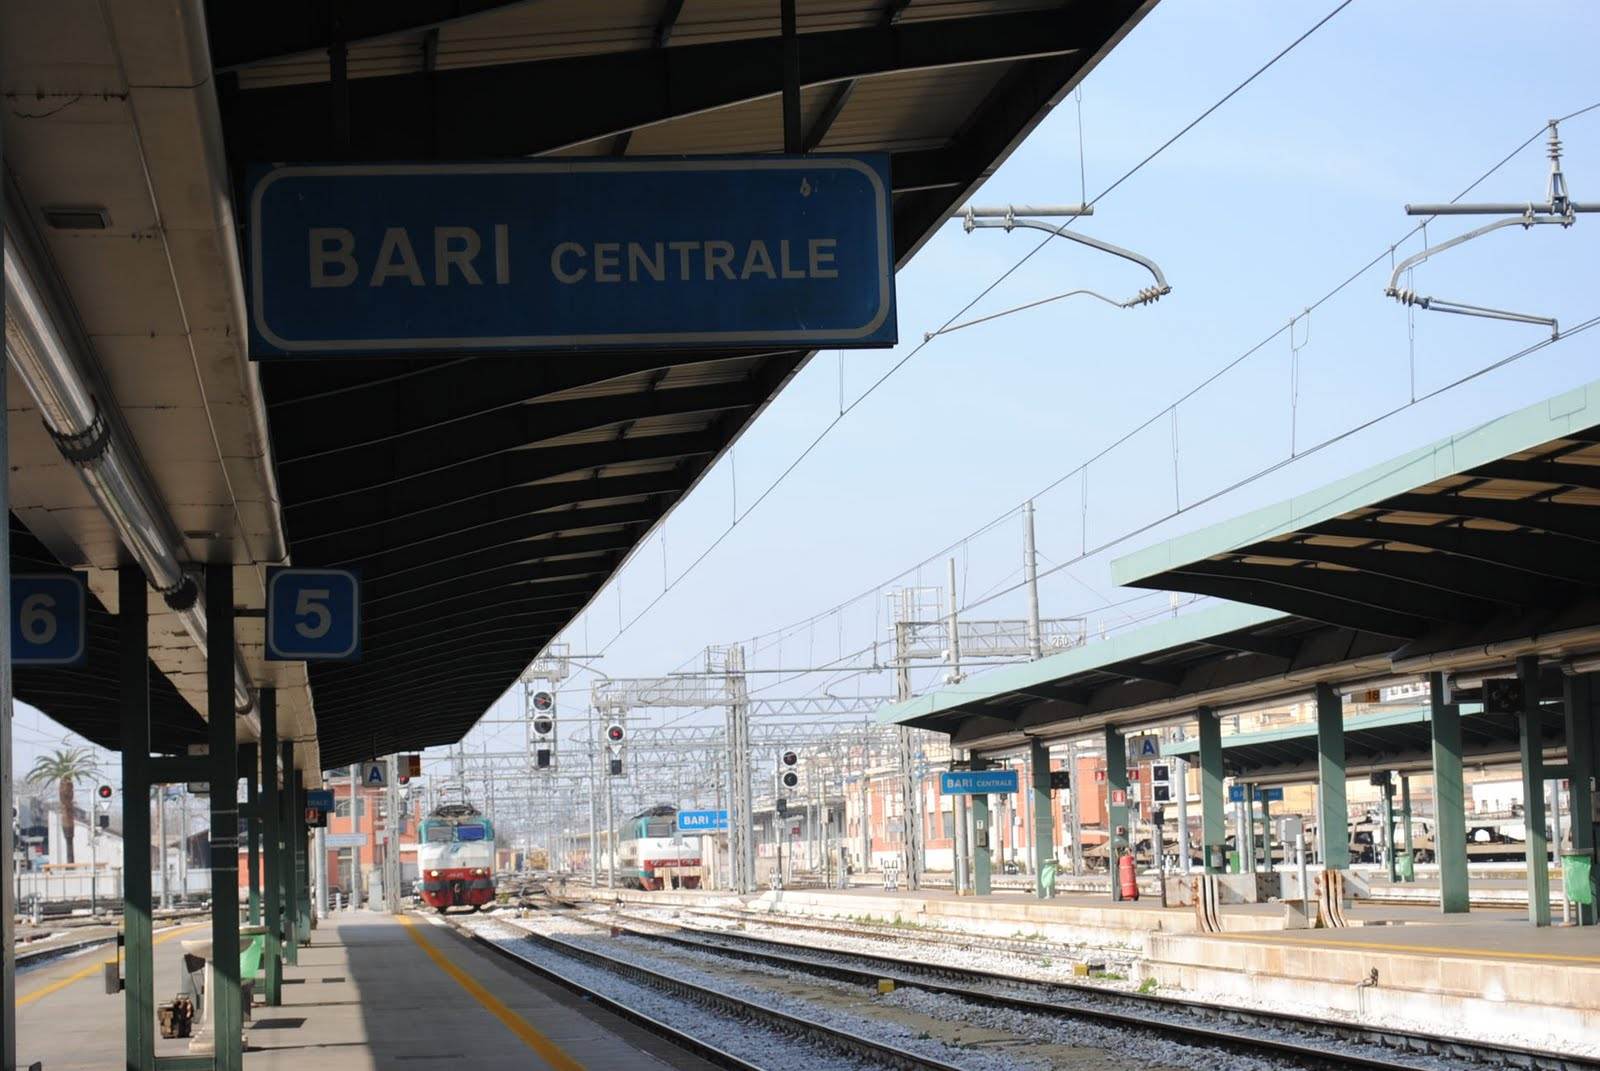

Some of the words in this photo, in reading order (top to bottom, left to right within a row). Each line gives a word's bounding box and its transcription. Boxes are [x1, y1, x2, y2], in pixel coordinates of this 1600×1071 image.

[307, 223, 511, 290] BARI
[550, 237, 840, 286] CENTRALE
[19, 593, 58, 645] 6
[293, 588, 333, 640] 5
[1142, 740, 1155, 755] A
[368, 766, 382, 782] A
[947, 778, 973, 789] BARI
[976, 779, 1012, 788] CENTRALE
[683, 815, 709, 825] BARI
